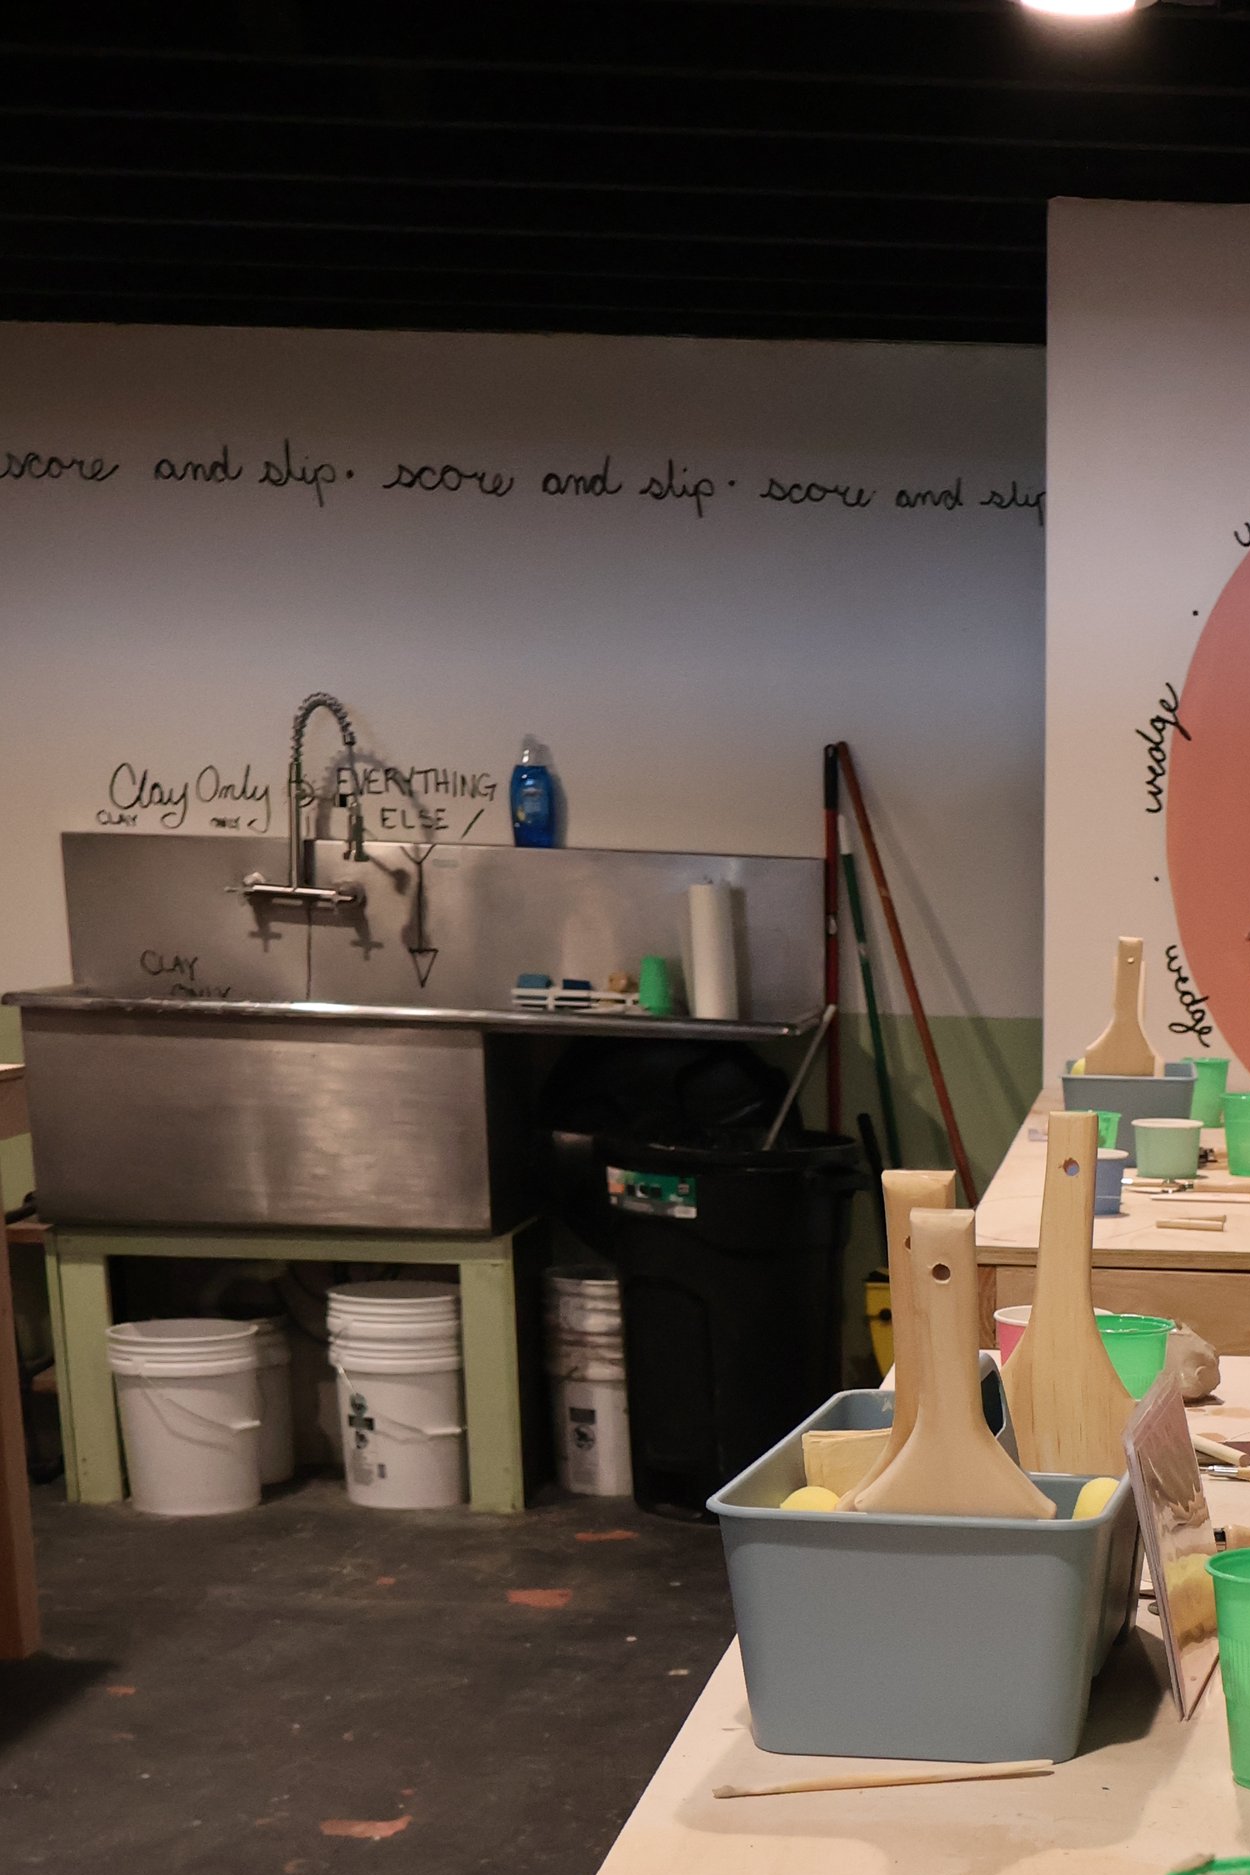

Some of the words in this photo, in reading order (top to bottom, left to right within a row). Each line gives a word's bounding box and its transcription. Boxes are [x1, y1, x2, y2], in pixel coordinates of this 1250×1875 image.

[0, 451, 120, 482] score
[154, 444, 243, 482] and
[382, 461, 515, 498] score
[541, 455, 623, 497] and
[760, 475, 874, 507] score
[895, 477, 963, 511] and
[1134, 682, 1192, 815] wedge
[109, 762, 189, 830] Clay
[196, 764, 271, 834] Only
[335, 766, 498, 802] EVERYTHING
[380, 807, 450, 831] ELSE
[1165, 944, 1213, 1048] wedge
